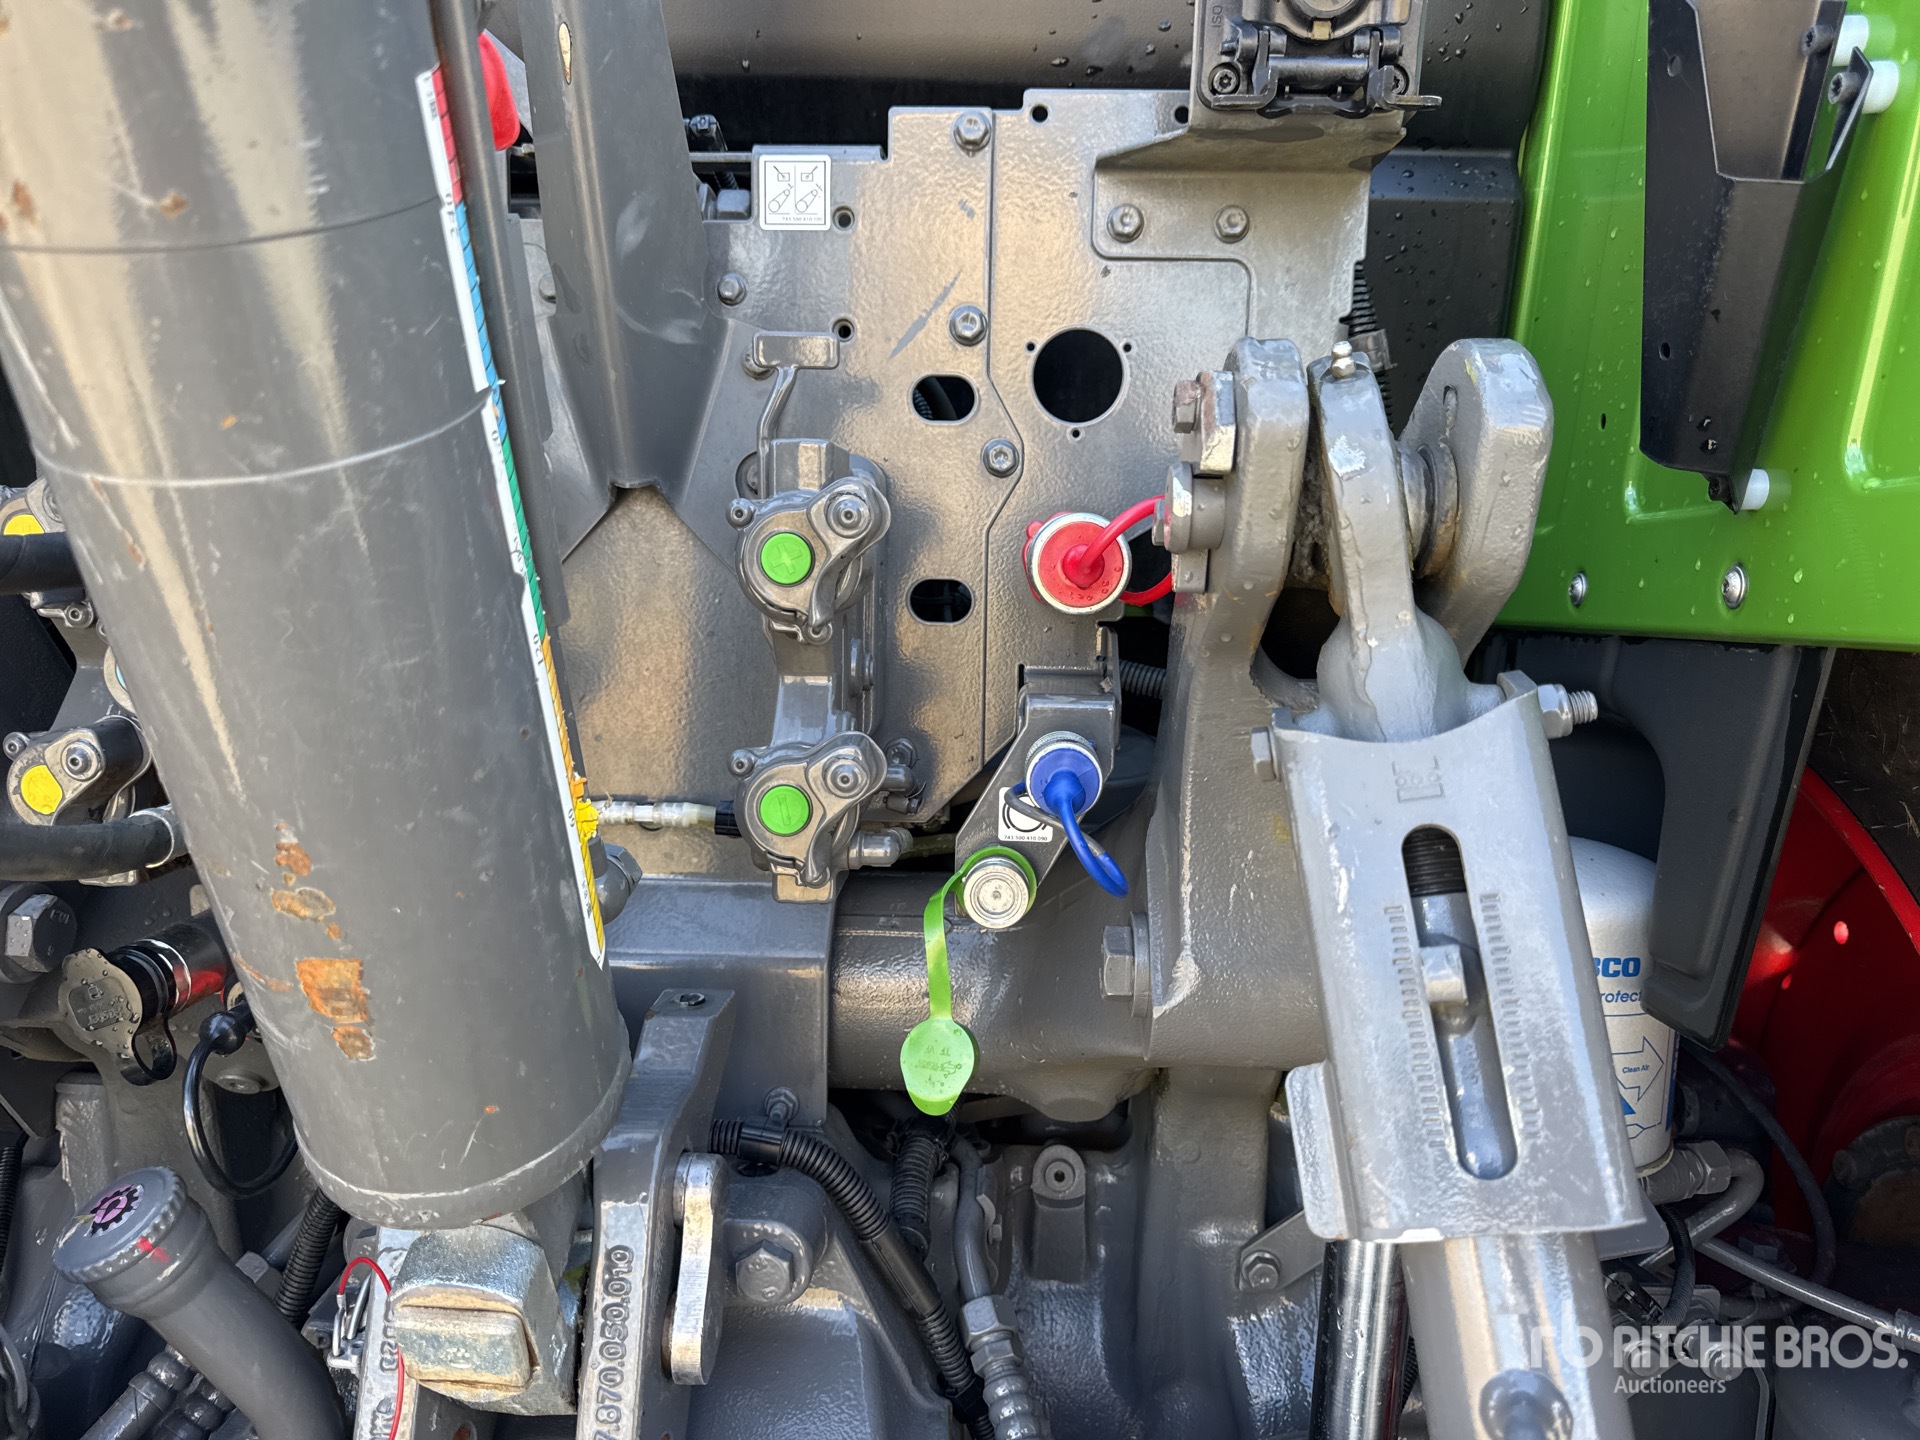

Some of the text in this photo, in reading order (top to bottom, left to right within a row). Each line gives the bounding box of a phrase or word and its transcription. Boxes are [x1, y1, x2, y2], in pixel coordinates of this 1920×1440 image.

[1211, 5, 1222, 27] ISO
[1622, 1063, 1650, 1074] Clean Air
